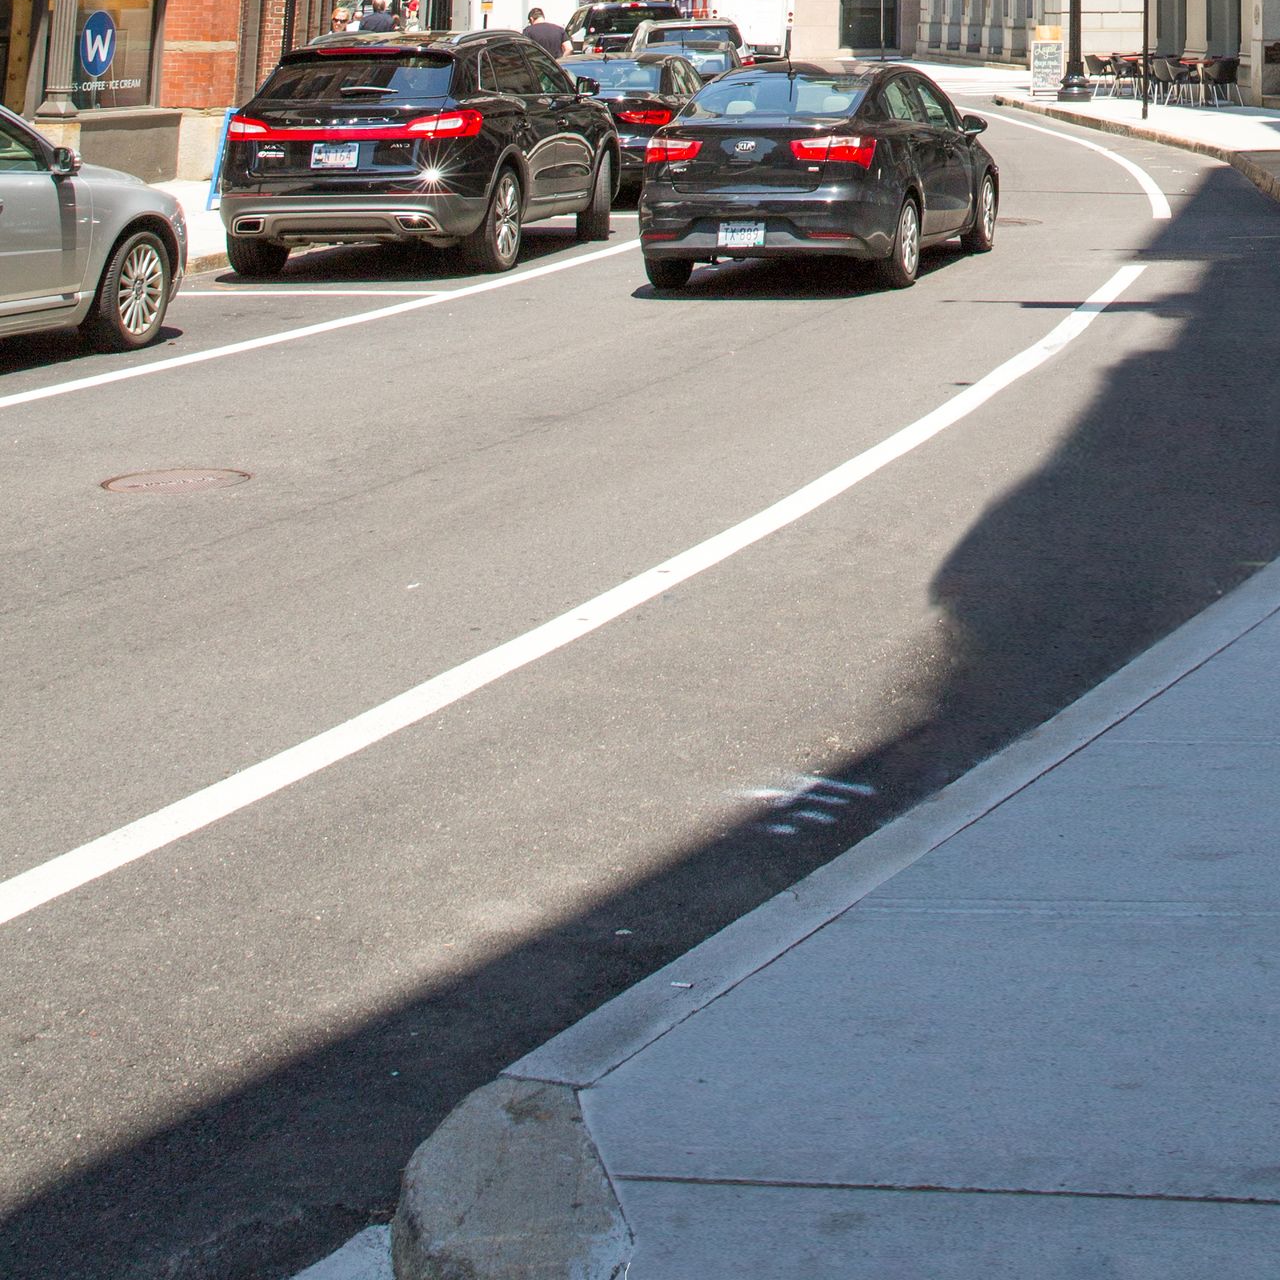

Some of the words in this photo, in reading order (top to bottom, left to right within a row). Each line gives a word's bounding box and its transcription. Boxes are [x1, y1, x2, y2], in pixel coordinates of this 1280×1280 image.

[86, 29, 112, 62] W
[82, 81, 105, 91] COFFEE
[109, 79, 119, 90] ICE
[120, 78, 141, 89] CREAM
[740, 142, 753, 152] KIA
